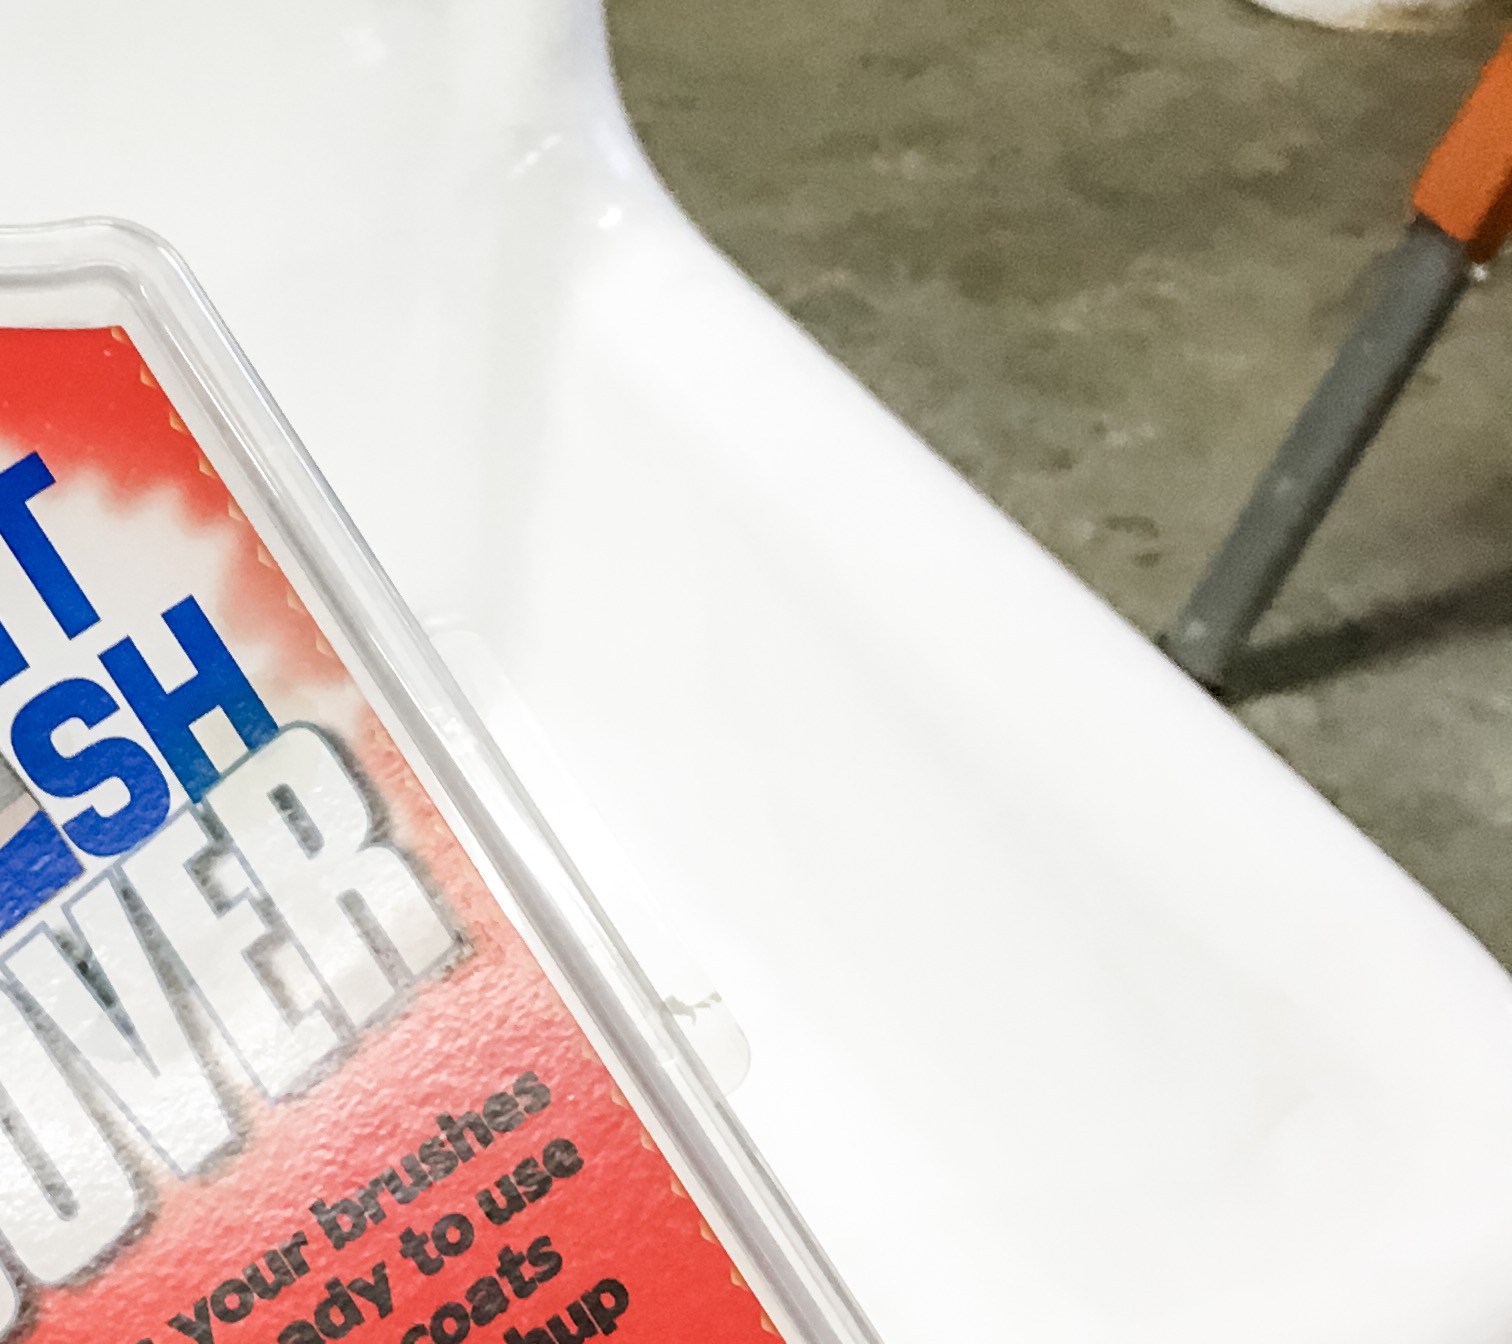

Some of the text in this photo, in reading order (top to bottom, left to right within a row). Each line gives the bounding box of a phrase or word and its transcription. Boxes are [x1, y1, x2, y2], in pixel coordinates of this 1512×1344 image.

[309, 1070, 552, 1250] brushes
[400, 1213, 475, 1276] to
[475, 1137, 584, 1225] use
